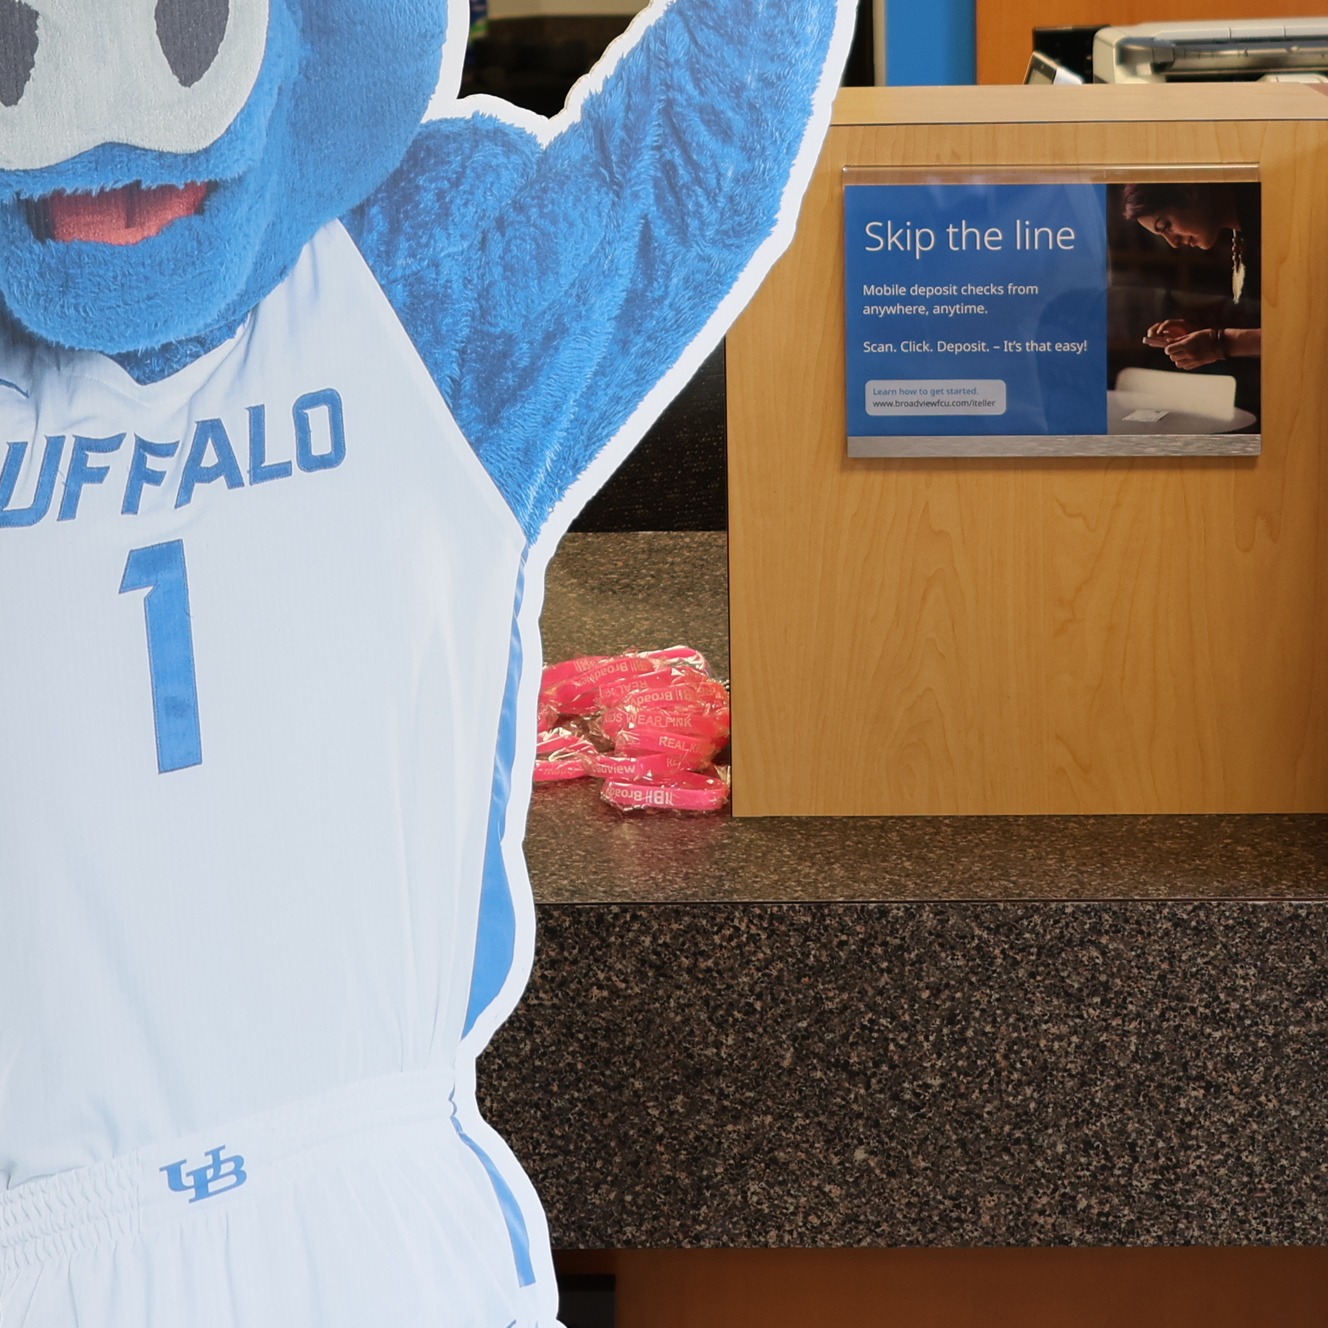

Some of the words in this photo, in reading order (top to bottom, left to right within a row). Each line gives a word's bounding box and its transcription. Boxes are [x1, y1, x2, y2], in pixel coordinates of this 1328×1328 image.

[864, 220, 935, 260] Skip
[946, 219, 1003, 250] the
[1016, 219, 1075, 250] line
[863, 284, 907, 296] Mobile
[909, 284, 958, 298] deposit
[960, 283, 1004, 295] checks
[1007, 283, 1039, 294] from
[862, 303, 929, 317] anywhere,
[932, 303, 988, 317] anytime.
[863, 341, 897, 352] Scan.
[900, 340, 933, 352] Click.
[937, 340, 990, 354] Deposit.
[1025, 340, 1053, 352] that
[1054, 340, 1088, 354] easy!
[872, 388, 897, 396] Learn
[899, 388, 916, 396] how
[919, 388, 928, 396] to
[930, 388, 945, 398] get
[946, 387, 980, 396] started.
[872, 398, 996, 409] www.broadviewfcu.com/iteller
[119, 538, 203, 775] 1
[627, 714, 662, 726] WEAR
[658, 735, 687, 750] REAL
[159, 1144, 248, 1204] UB
